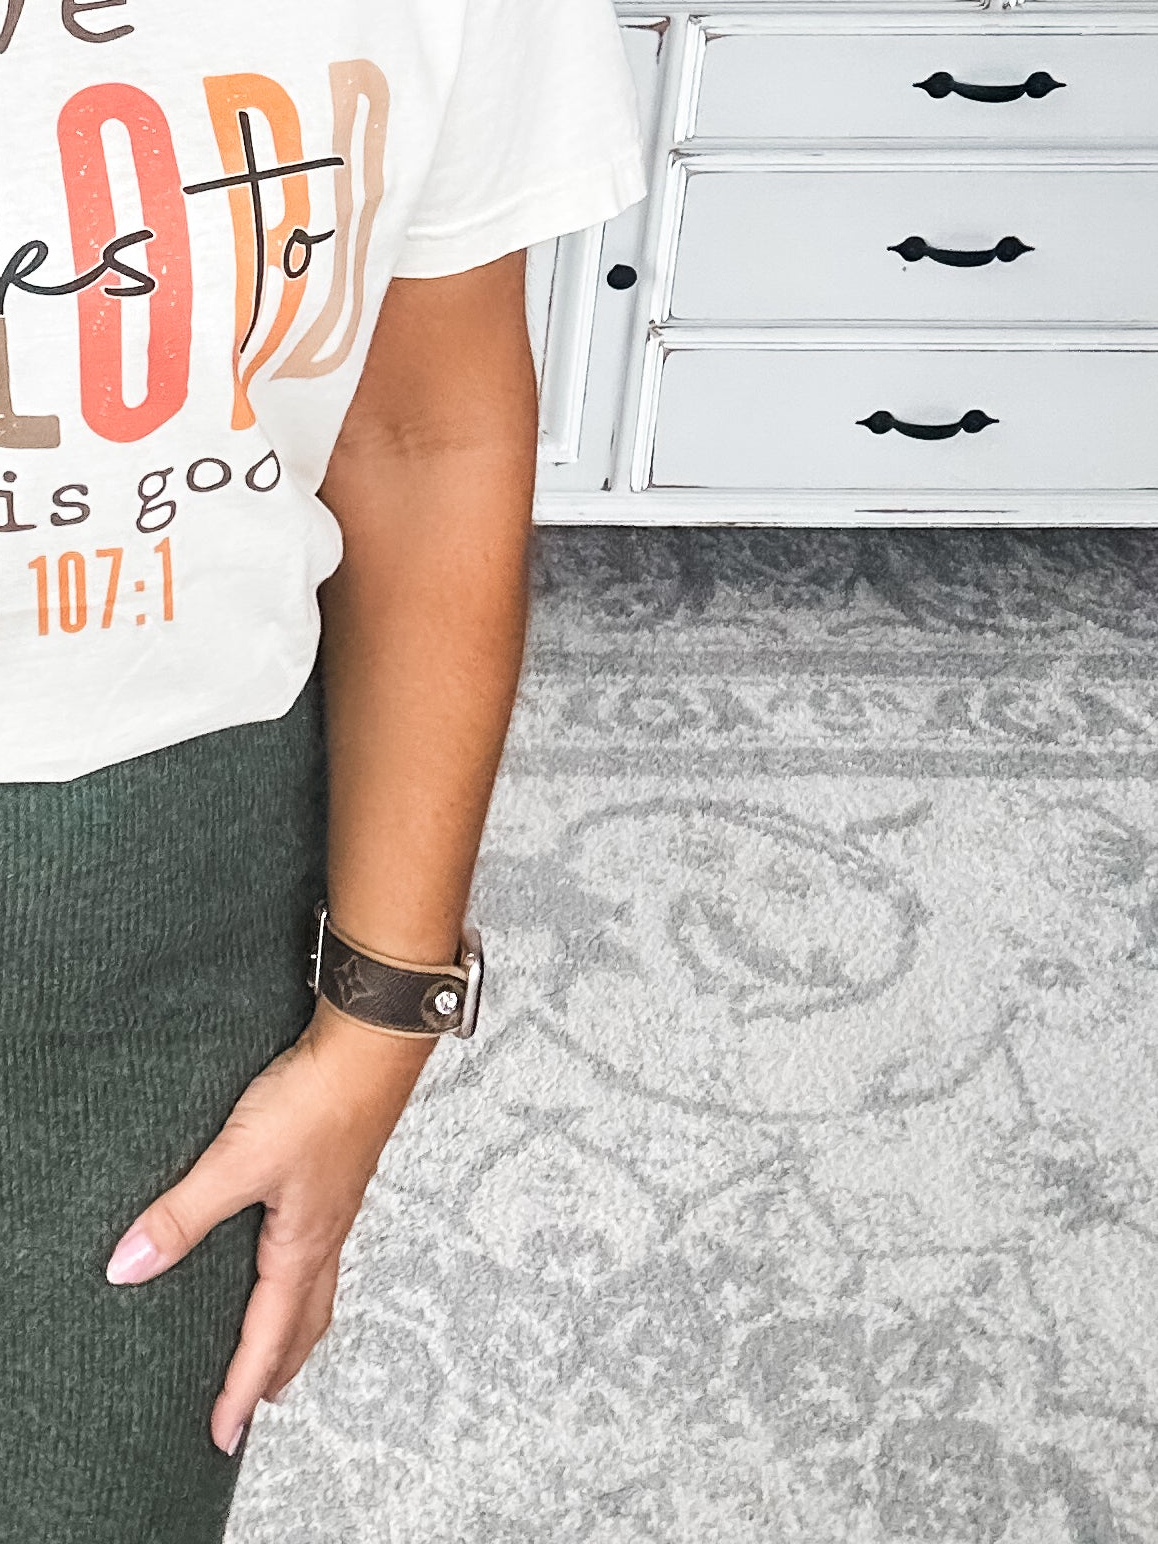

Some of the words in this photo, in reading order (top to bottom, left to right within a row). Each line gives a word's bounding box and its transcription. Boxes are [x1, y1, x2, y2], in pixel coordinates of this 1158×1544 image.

[182, 111, 345, 354] to
[136, 447, 282, 534] goo
[27, 536, 175, 636] 107:1
